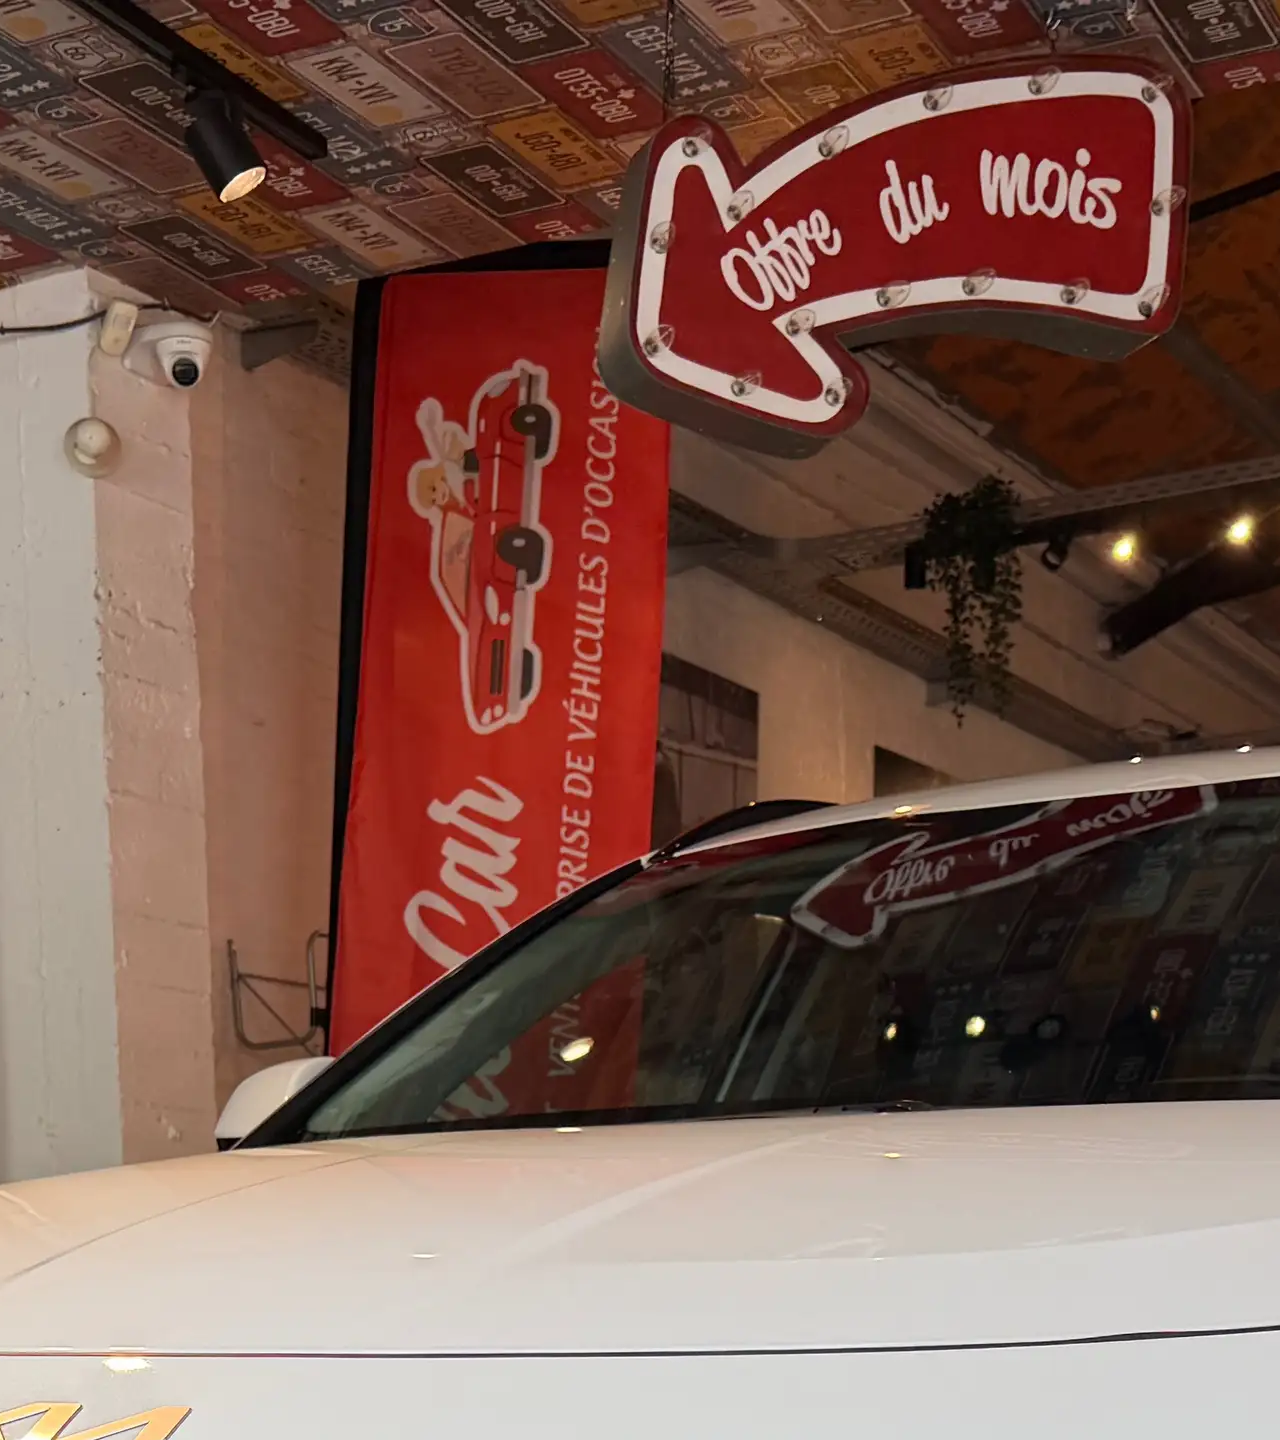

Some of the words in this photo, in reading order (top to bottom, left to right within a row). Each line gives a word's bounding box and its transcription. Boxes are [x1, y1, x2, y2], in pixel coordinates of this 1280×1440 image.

[720, 205, 842, 313] Offre
[879, 159, 950, 245] du
[979, 148, 1122, 230] mois
[581, 326, 620, 545] D'OCCAS
[562, 552, 610, 742] VÉHICULES
[563, 750, 596, 799] DE
[404, 775, 525, 972] Car
